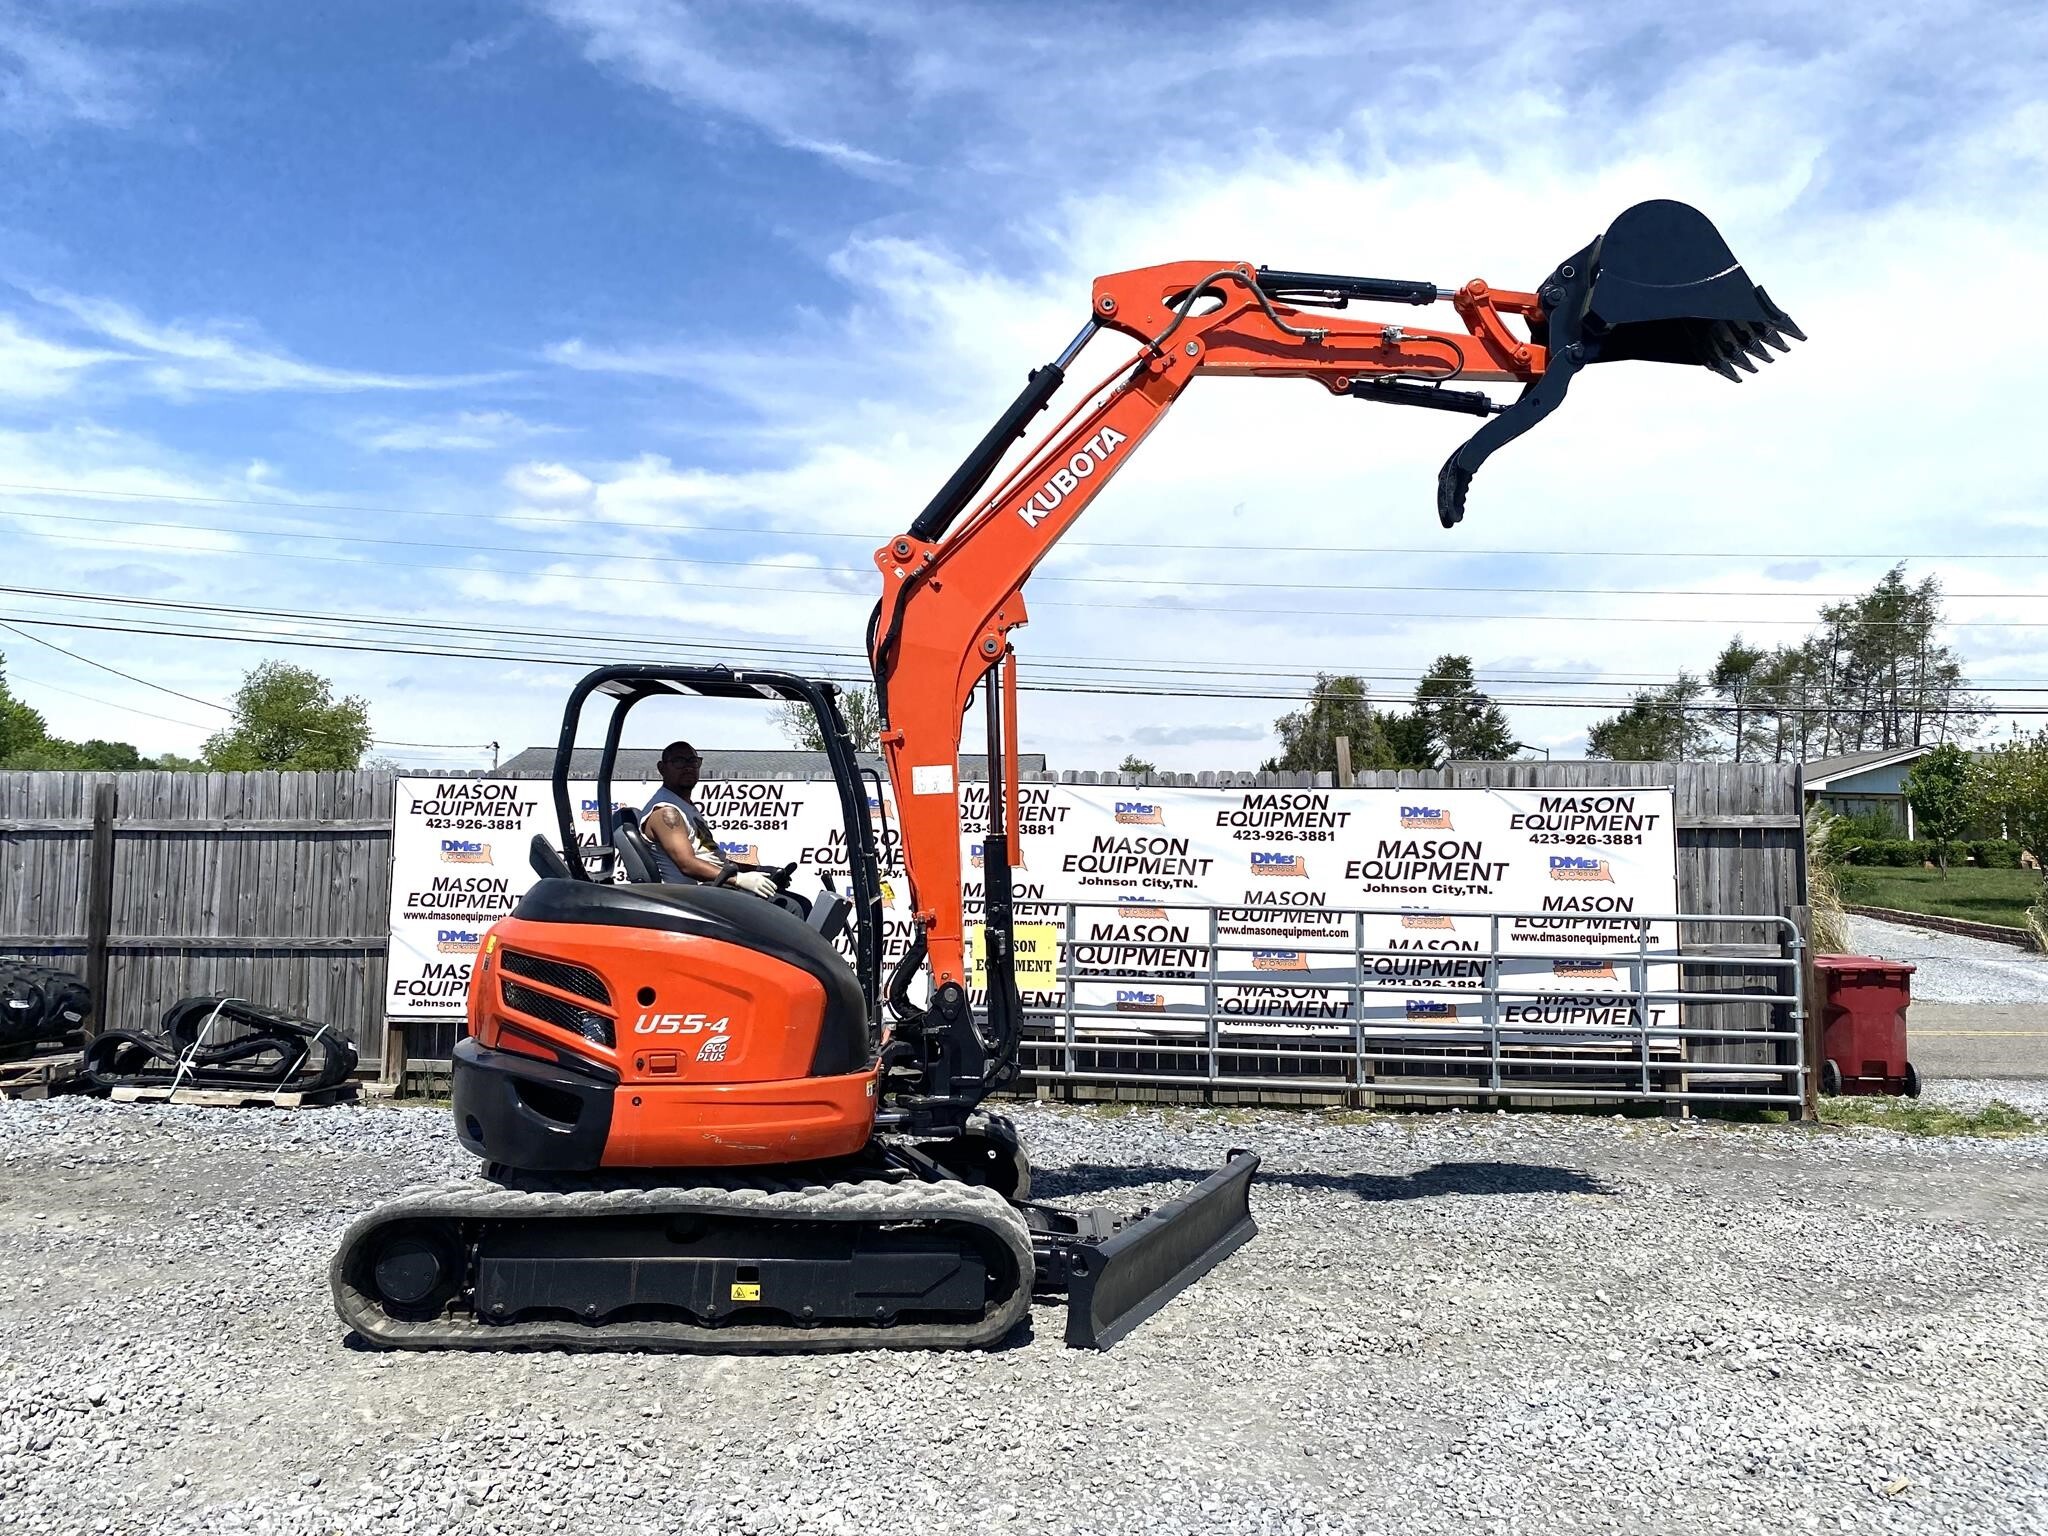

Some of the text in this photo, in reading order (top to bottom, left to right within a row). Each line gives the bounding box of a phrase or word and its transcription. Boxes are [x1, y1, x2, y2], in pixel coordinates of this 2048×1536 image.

[1017, 425, 1128, 528] KUBOTA
[435, 783, 518, 800] MASON
[700, 784, 784, 800] MASON
[409, 799, 538, 817] EQUIPMENT
[692, 801, 804, 817] QUIPMENT
[1242, 793, 1329, 810] MASON
[1538, 796, 1635, 813] MASON
[425, 818, 522, 830] 423-926-3881
[706, 820, 788, 830] 3-926-3881
[1216, 811, 1351, 828] EQUIPMENT
[1510, 814, 1660, 831] EQUIPMENT
[1232, 830, 1335, 841] 423-926-3881
[1529, 834, 1642, 845] 423-926-3881
[1092, 835, 1189, 856] MASON
[1376, 840, 1482, 860] MASON
[1062, 854, 1214, 876] EQUIPMENT
[1344, 861, 1510, 882] EQUIPMENT
[431, 876, 509, 893] MASON
[1078, 876, 1198, 890] Johnson City,TN.
[1362, 883, 1493, 896] Johnson City,TN.
[1243, 890, 1326, 906] MASON
[1542, 896, 1634, 912] MASON
[1090, 923, 1190, 943] MASON
[421, 963, 471, 980] MAS
[975, 958, 1052, 973] EMENT
[393, 980, 470, 997] EQUIP
[408, 999, 461, 1008] Johnson
[705, 1043, 727, 1053] eco
[695, 1052, 726, 1062] PLUS
